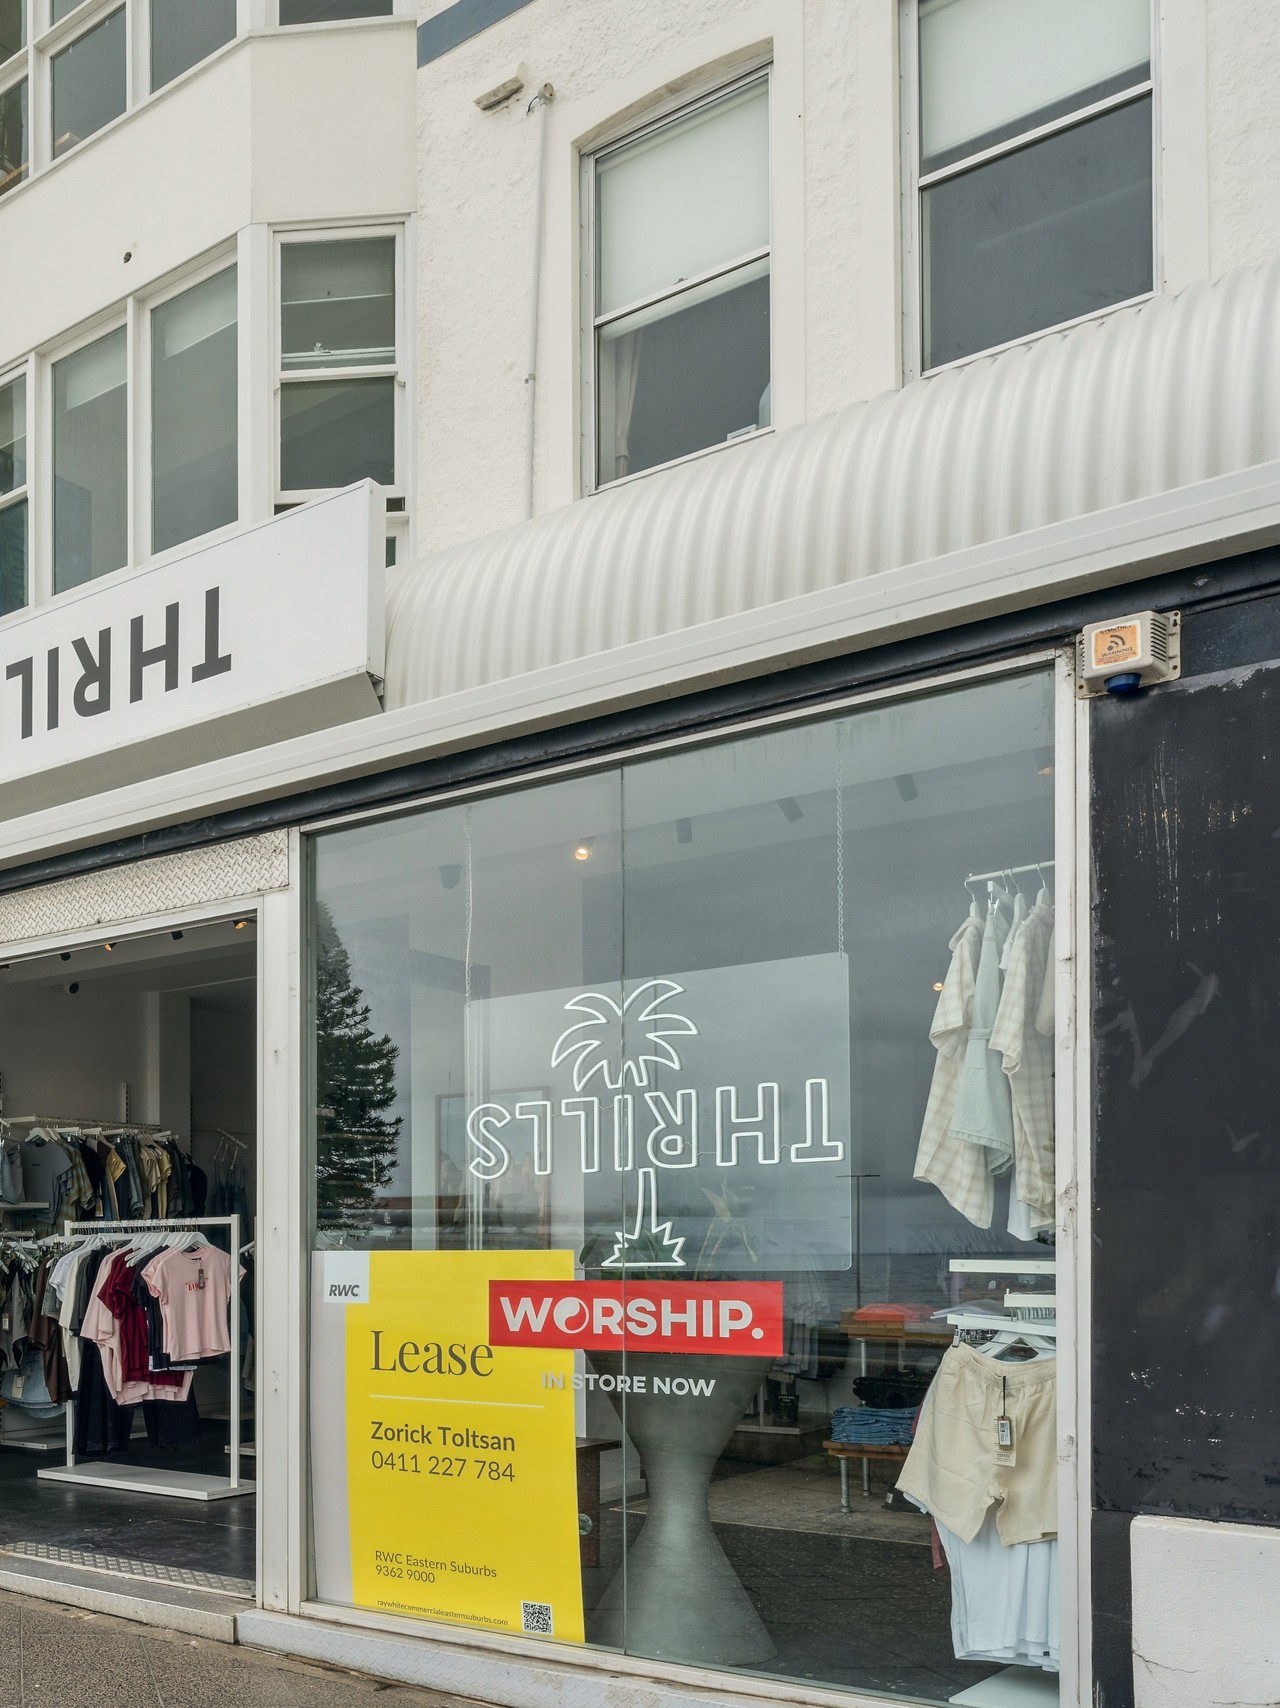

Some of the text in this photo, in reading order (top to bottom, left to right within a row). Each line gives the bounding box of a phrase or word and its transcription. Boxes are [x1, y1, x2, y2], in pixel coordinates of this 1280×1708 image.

[1101, 646, 1133, 658] WARNING
[466, 1078, 845, 1180] THRILLS
[329, 1284, 360, 1297] RWC
[500, 1296, 765, 1340] WORSHIP.
[370, 1329, 495, 1378] Lease
[541, 1372, 717, 1397] IN STORE NOW
[370, 1421, 516, 1451] Zorick Toltsan
[371, 1450, 516, 1482] 0411 227 784
[375, 1550, 498, 1577] RWC Eastern Suburbs
[375, 1564, 436, 1584] 9362 9000
[377, 1600, 509, 1627] raywhitecommercialeasternsuburbs.com
